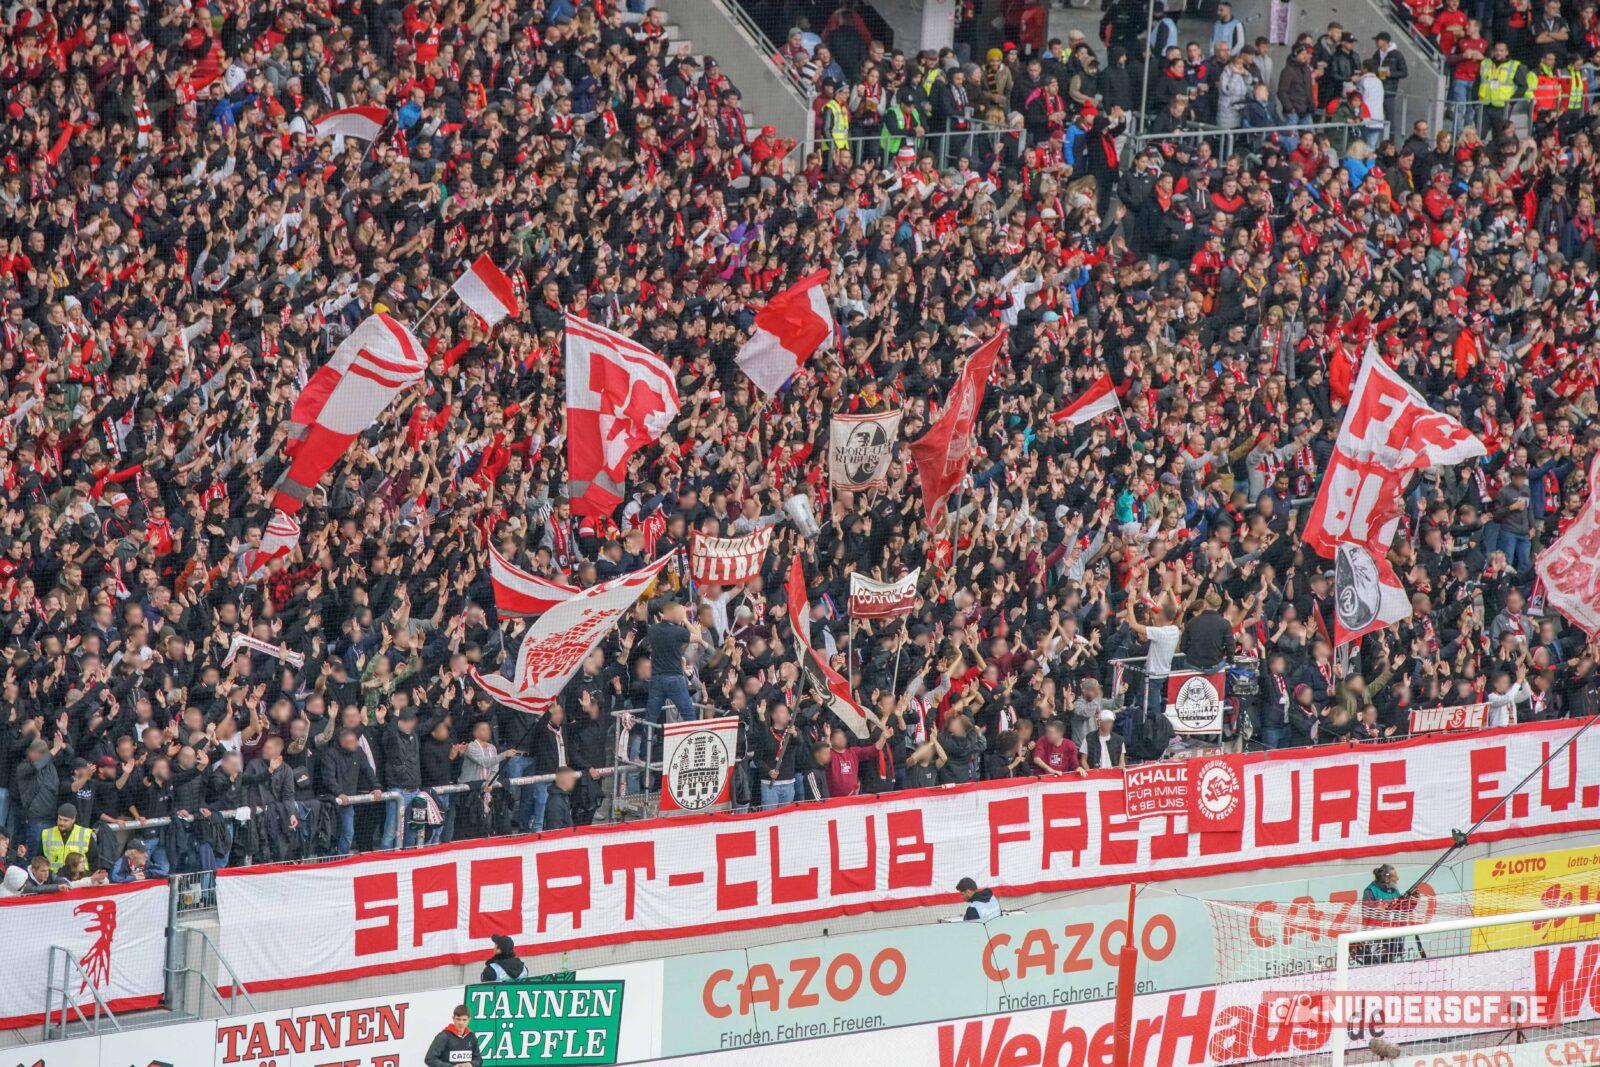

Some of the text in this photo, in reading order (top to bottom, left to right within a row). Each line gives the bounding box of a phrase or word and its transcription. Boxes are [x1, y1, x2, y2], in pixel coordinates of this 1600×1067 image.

[692, 551, 767, 581] ULTRA
[1128, 785, 1188, 802] FÜR IMME
[1139, 797, 1185, 811] BEI UNS
[1215, 797, 1239, 820] RECHTS
[988, 759, 1415, 877] FREIURG
[1508, 857, 1547, 875] LOTTO
[982, 913, 1177, 983] CAZOO
[702, 947, 907, 1019] CAZOO
[999, 991, 1050, 1011] Finden.
[1052, 985, 1105, 1004] Fahren.
[472, 988, 617, 1020] TANNEN
[217, 1002, 410, 1064] TANNEN
[476, 1022, 607, 1060] ZÄPFLE
[720, 1014, 886, 1049] Finden. Fahren. Freuen.
